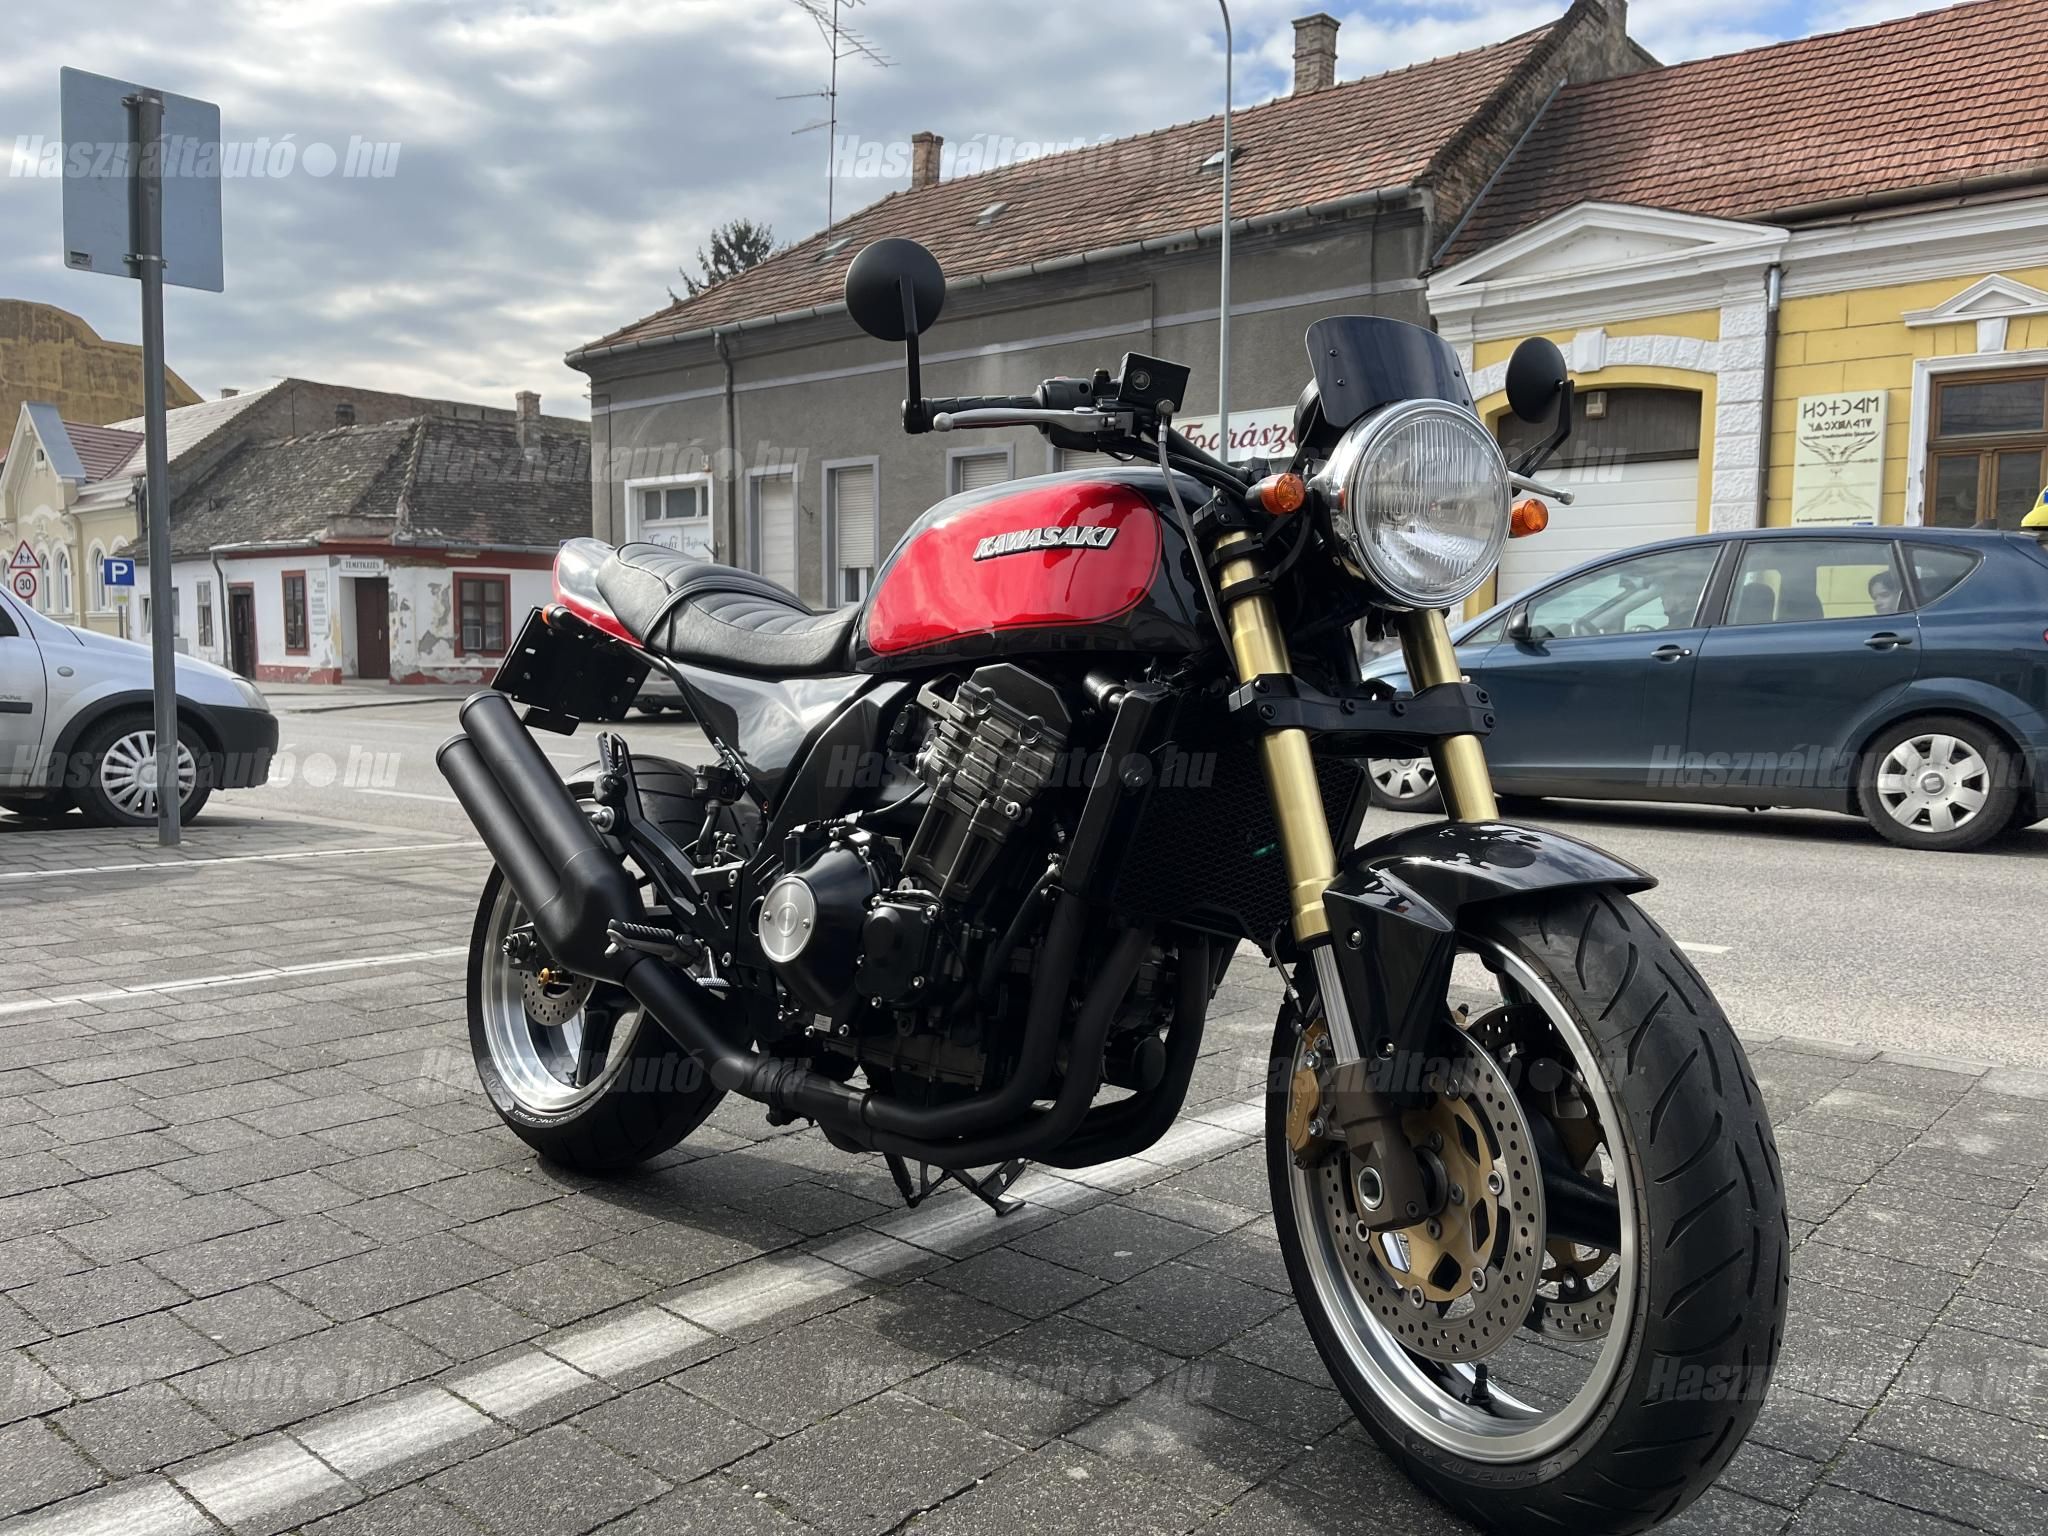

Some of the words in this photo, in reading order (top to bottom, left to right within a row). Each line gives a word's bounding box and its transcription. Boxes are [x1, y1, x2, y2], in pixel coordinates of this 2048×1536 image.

[1177, 422, 1295, 453] Forász
[973, 525, 1118, 559] KAWASAKI
[19, 578, 31, 590] 30
[111, 562, 128, 583] P
